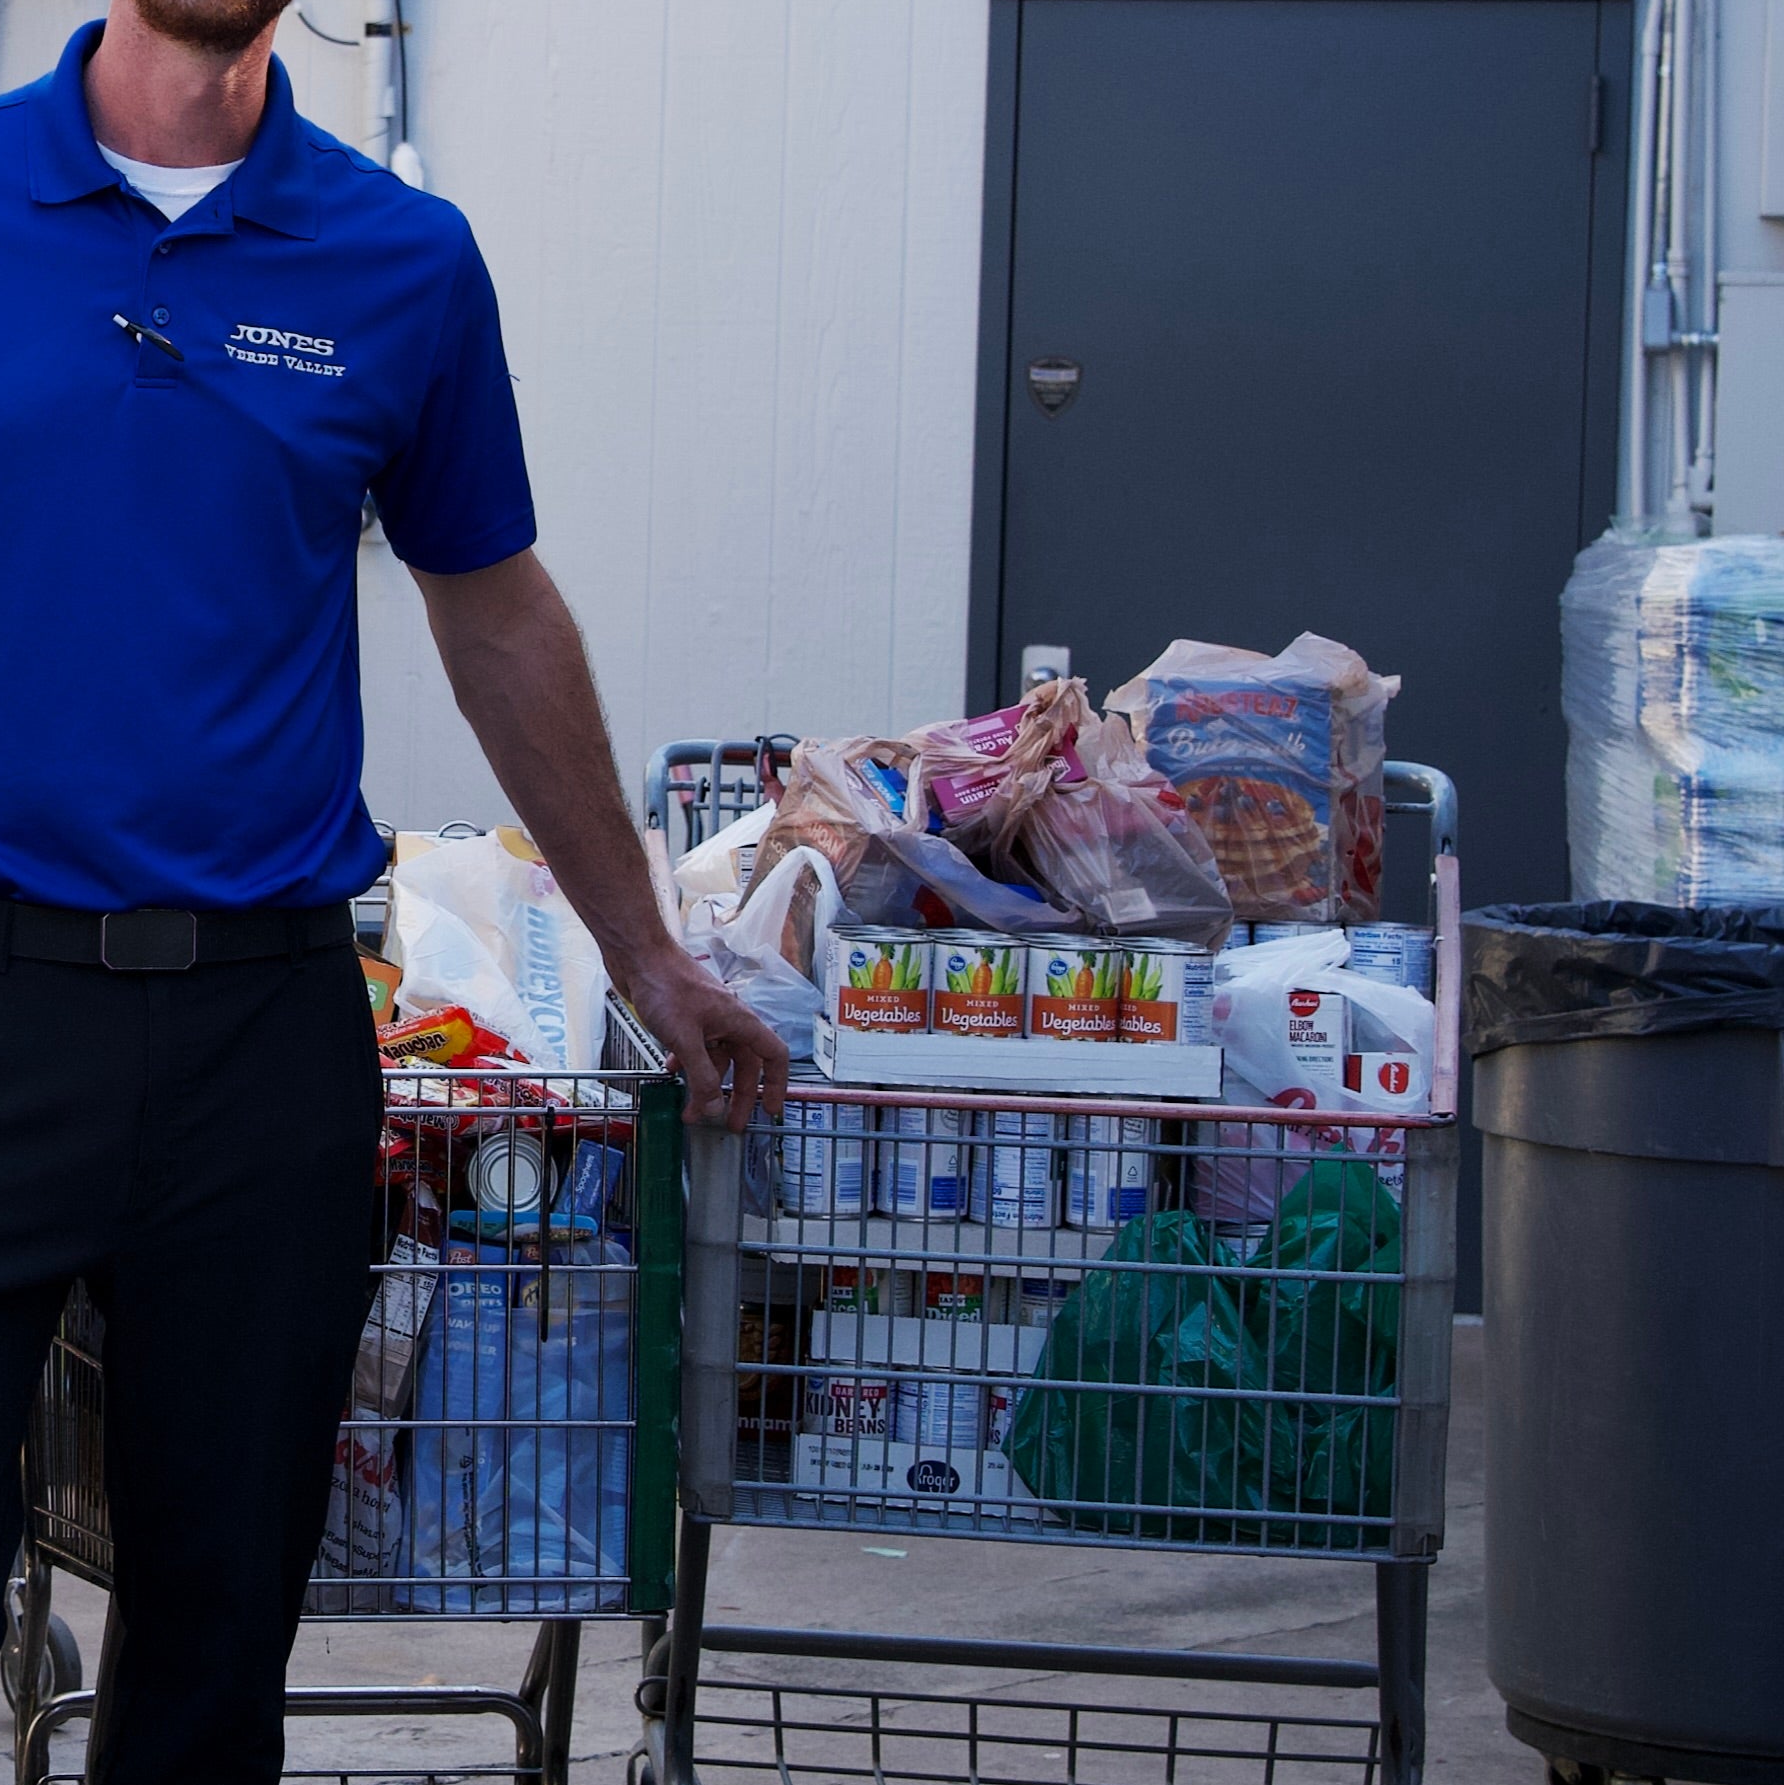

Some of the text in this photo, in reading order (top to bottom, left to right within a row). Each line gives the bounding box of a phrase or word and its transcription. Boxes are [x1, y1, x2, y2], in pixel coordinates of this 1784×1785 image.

[230, 324, 335, 357] JONES
[224, 343, 346, 378] VERDE VALLEY
[866, 994, 900, 1004] MIXED
[965, 999, 1000, 1009] MIXED
[843, 1002, 922, 1028] Vegetables
[1067, 1003, 1100, 1013] MIXED
[941, 1007, 1018, 1031] Vegetables
[1041, 1011, 1117, 1034] Vegetables
[1288, 1019, 1314, 1032] ELBOW
[1288, 1031, 1328, 1044] MACARONI
[449, 1250, 472, 1264] Post
[449, 1281, 503, 1297] OREO
[834, 1418, 886, 1434] BEANS
